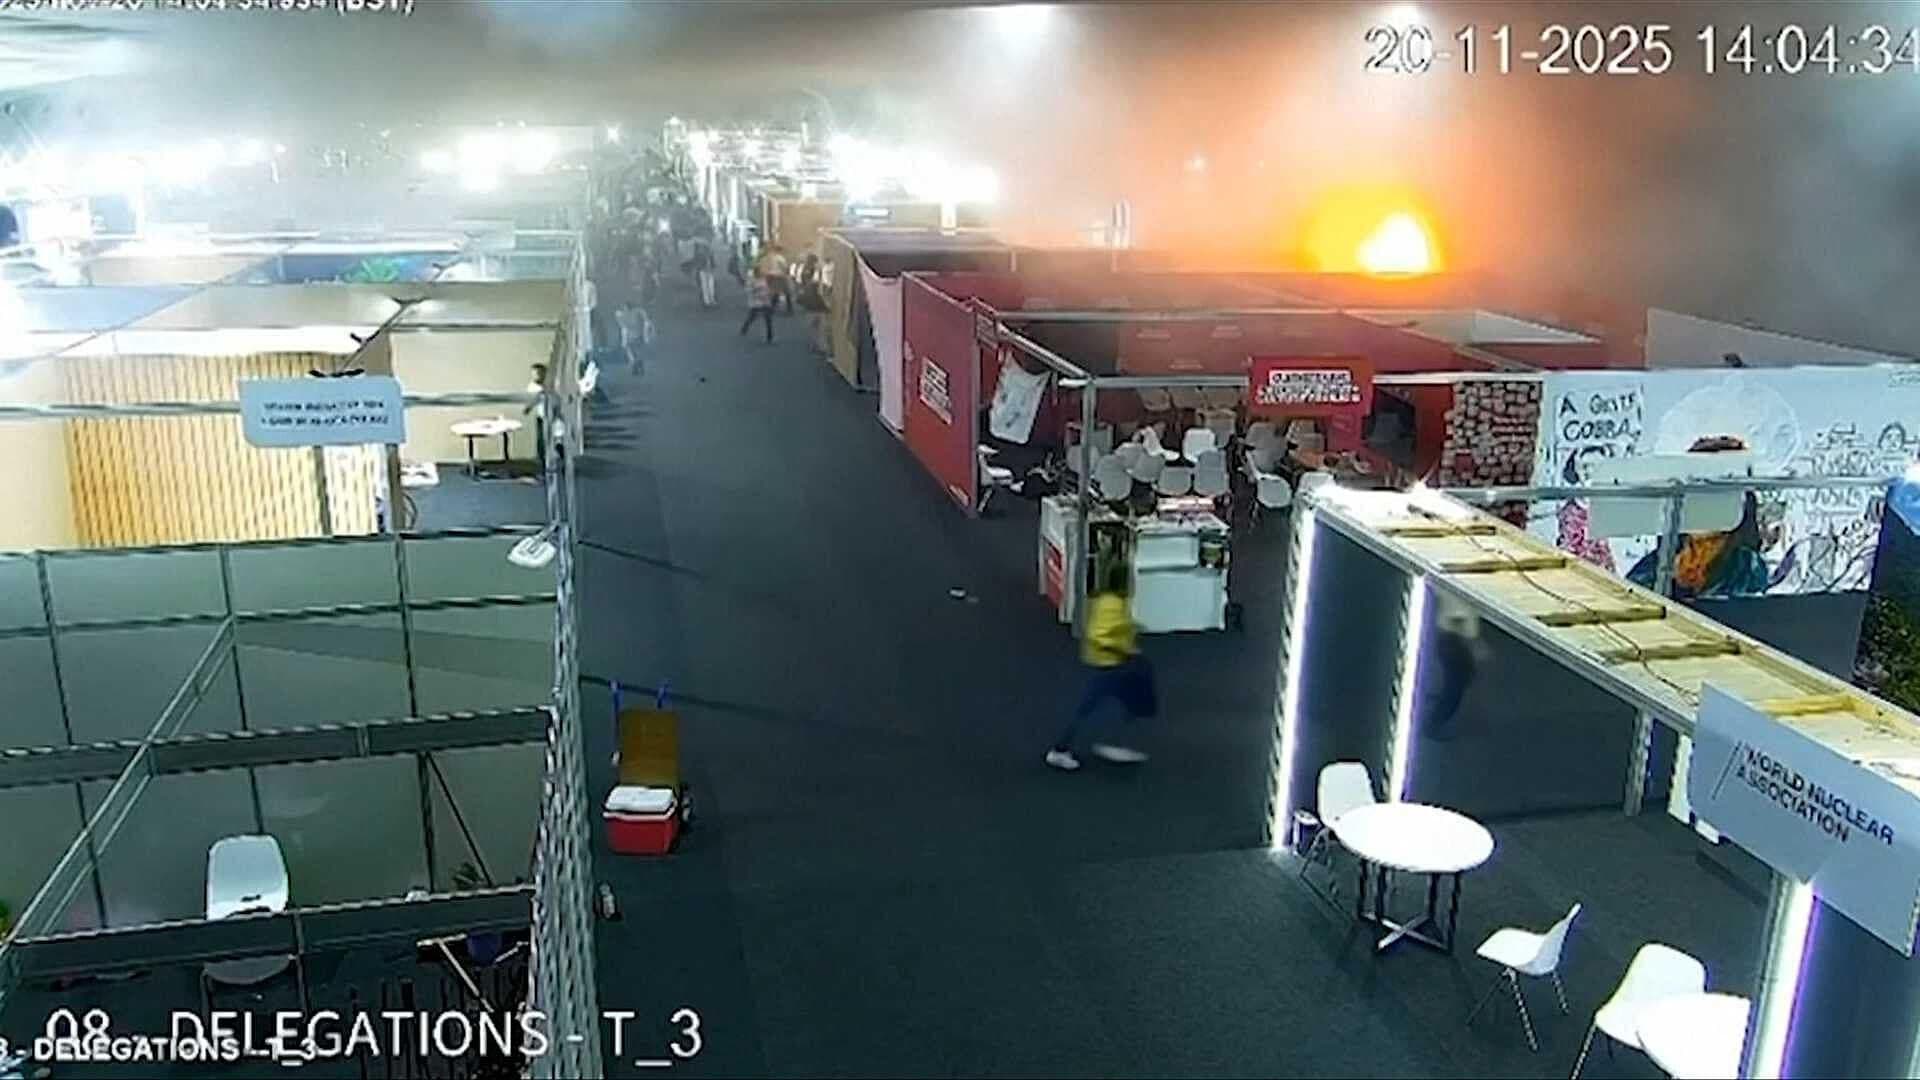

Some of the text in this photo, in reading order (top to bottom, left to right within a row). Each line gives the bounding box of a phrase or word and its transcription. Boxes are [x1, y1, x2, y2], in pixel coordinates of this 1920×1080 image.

[1559, 395, 1578, 417] A
[1736, 765, 1850, 843] ASSOCIATION
[1743, 745, 1895, 846] WORLD NUCLEAR
